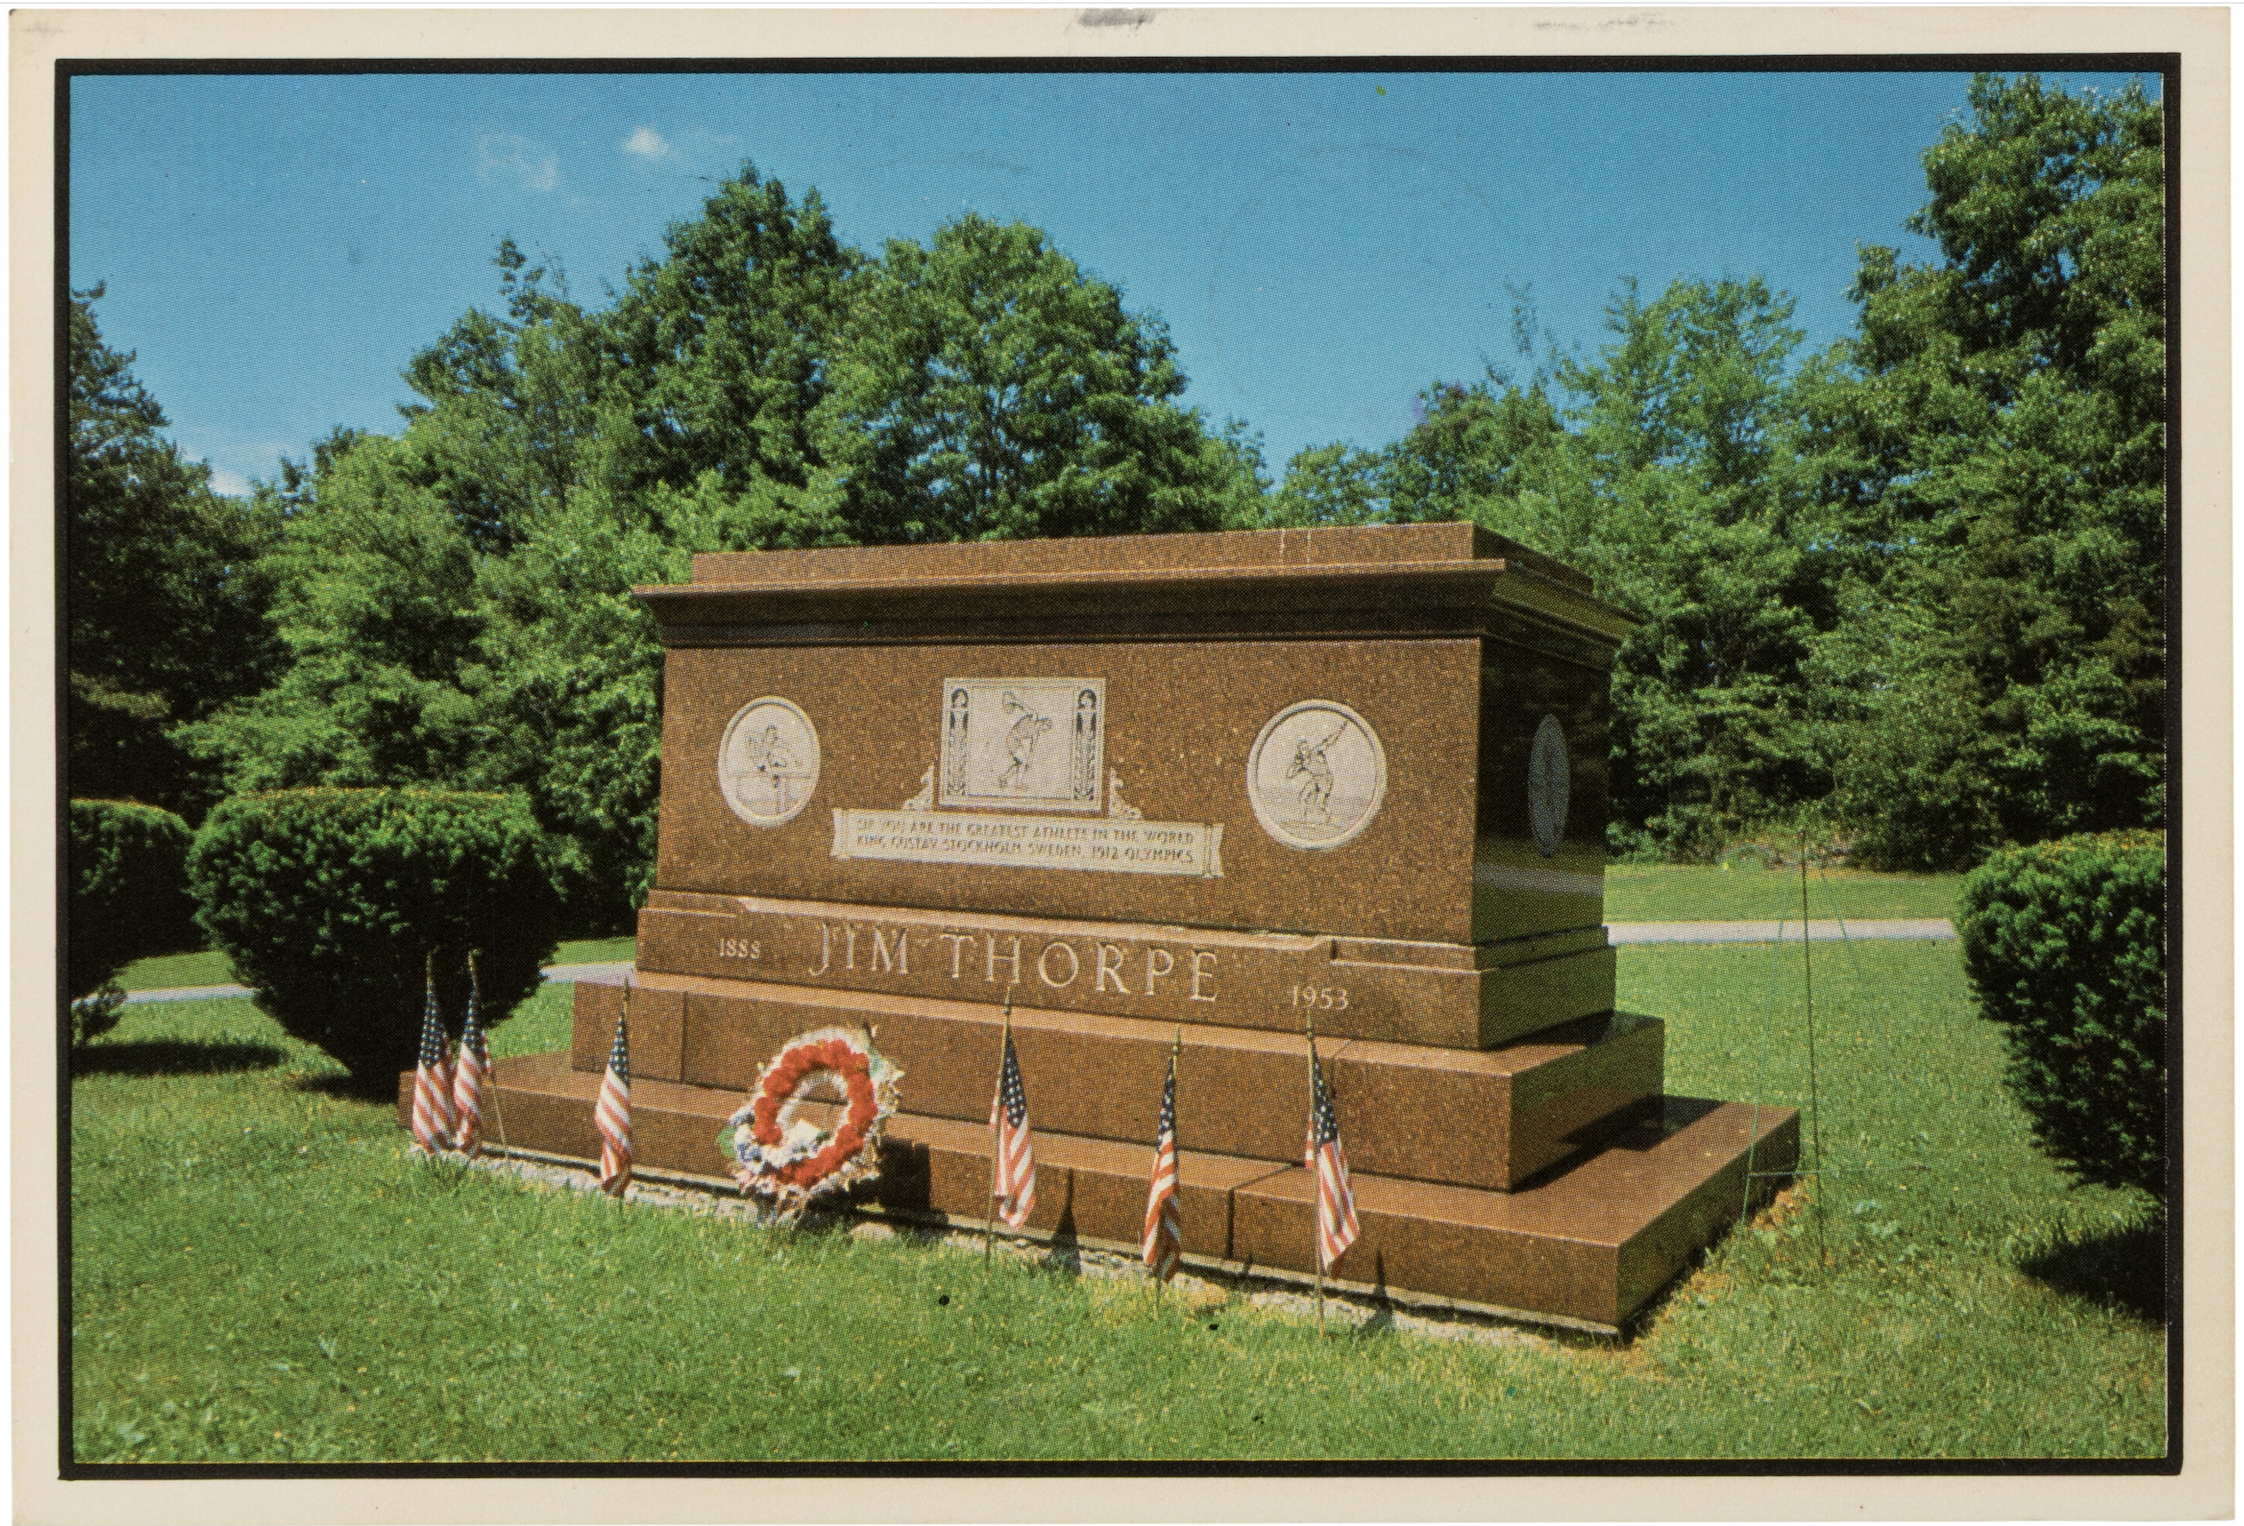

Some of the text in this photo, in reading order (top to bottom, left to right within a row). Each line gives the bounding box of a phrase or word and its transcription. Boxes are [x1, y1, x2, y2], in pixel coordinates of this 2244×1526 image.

[910, 821, 933, 834] ARE
[939, 822, 962, 835] THE
[967, 823, 1028, 839] GREATEST
[1033, 826, 1088, 841] ATHLETE
[1092, 828, 1109, 841] IN
[1113, 829, 1138, 843] THE
[1143, 829, 1195, 845] WORLD
[856, 834, 886, 849] KING
[1091, 845, 1119, 861] 1912
[1124, 846, 1195, 865] OLYMPICS
[719, 938, 761, 959] 1888
[808, 921, 1219, 1002] JIM THORPE
[1292, 985, 1350, 1010] 1953
